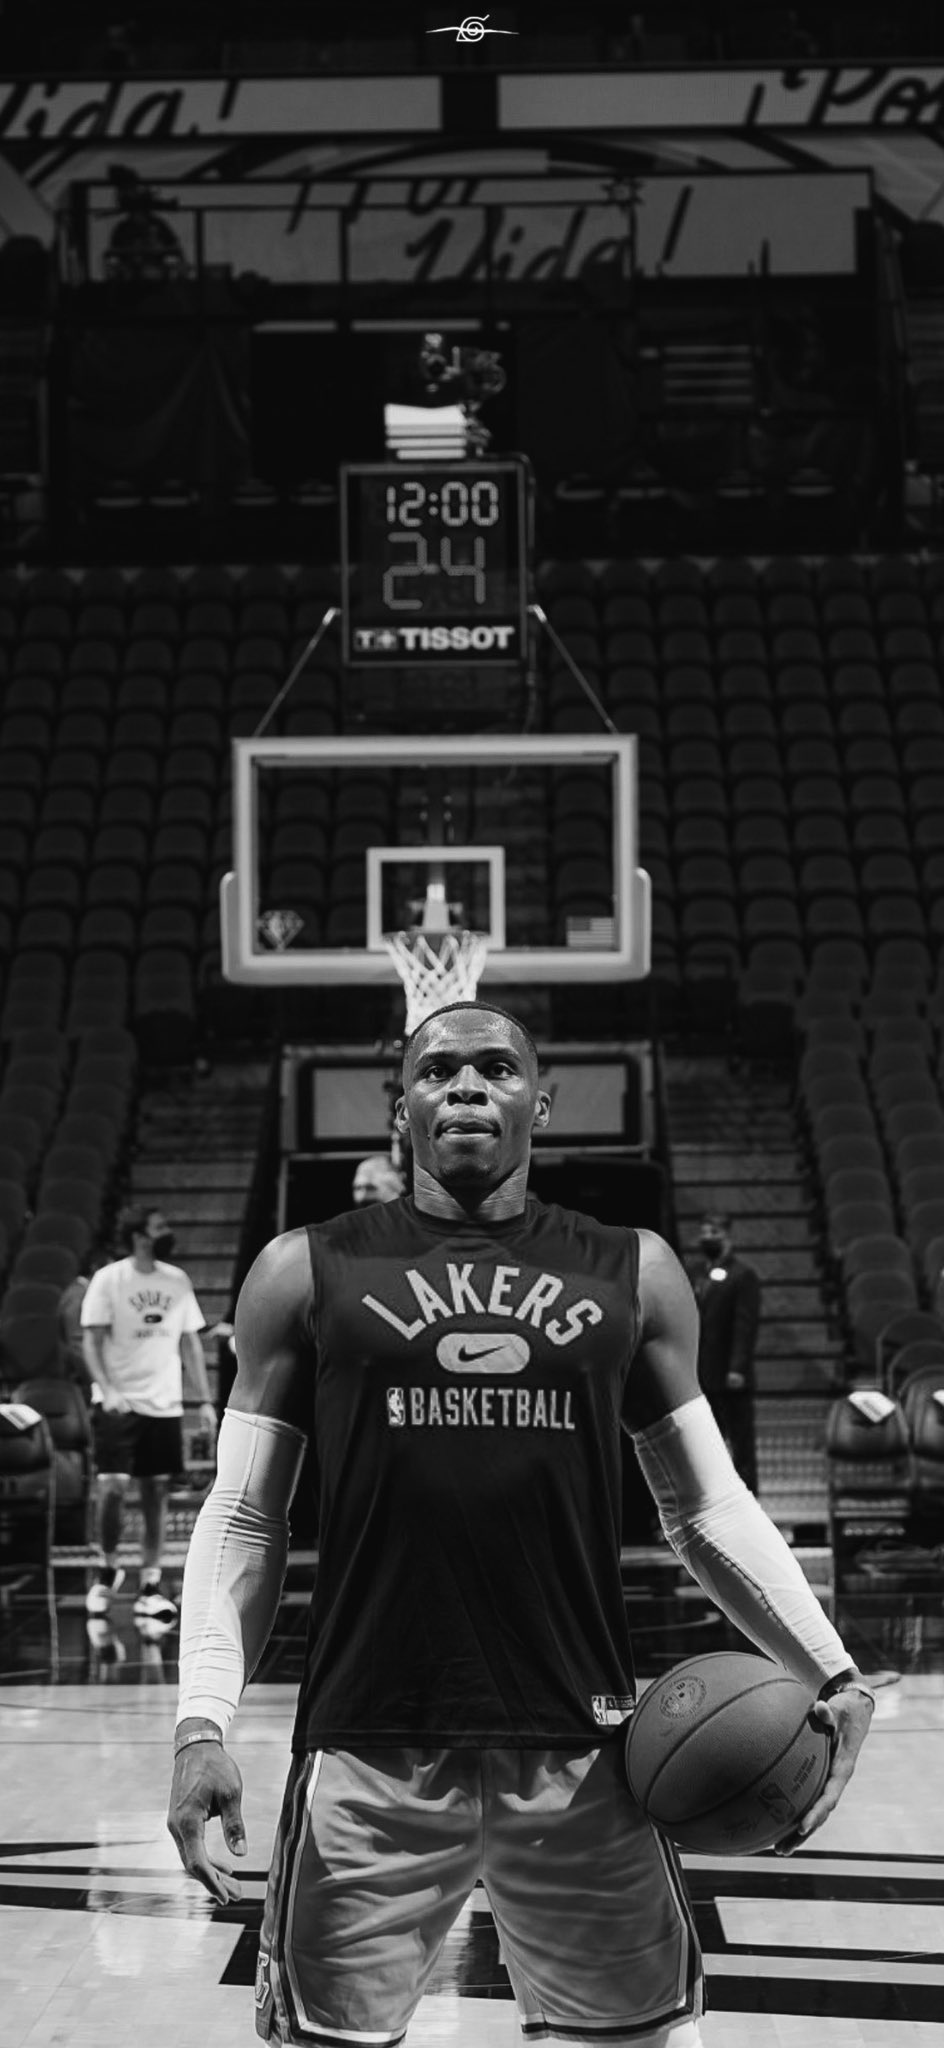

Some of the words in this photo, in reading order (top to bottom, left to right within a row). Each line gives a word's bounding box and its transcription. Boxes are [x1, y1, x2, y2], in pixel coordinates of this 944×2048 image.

[386, 481, 499, 527] 12:00
[383, 532, 486, 610] 24
[398, 626, 515, 650] TISSOT
[361, 1263, 603, 1346] LAKERS
[409, 1387, 575, 1430] BASKETBALL
